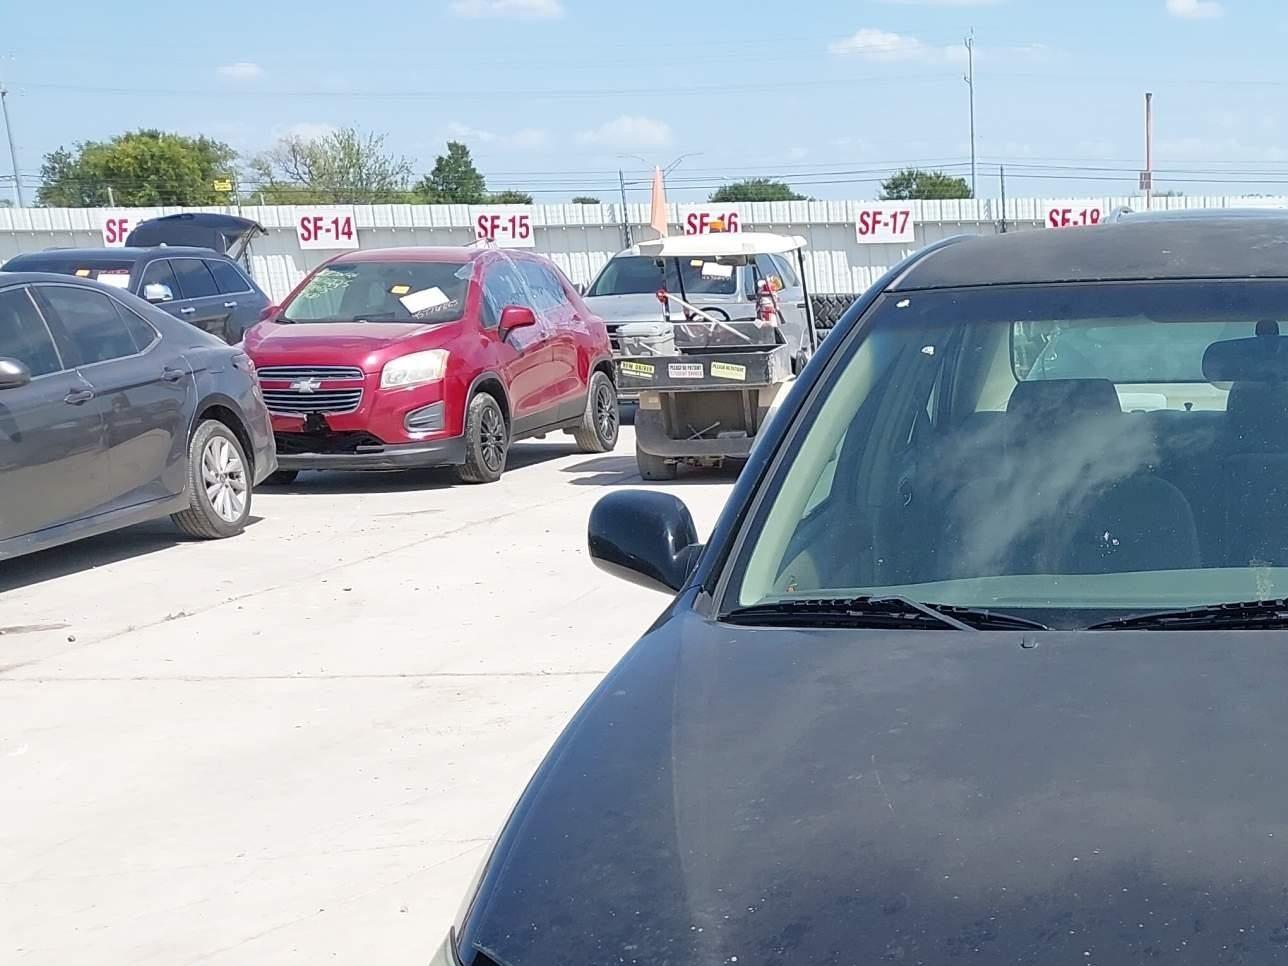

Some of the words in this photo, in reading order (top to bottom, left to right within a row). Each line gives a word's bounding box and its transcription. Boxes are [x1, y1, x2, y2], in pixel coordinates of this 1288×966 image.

[300, 216, 353, 242] SF-14
[477, 214, 530, 240] SF-15
[858, 210, 910, 236] SF-17
